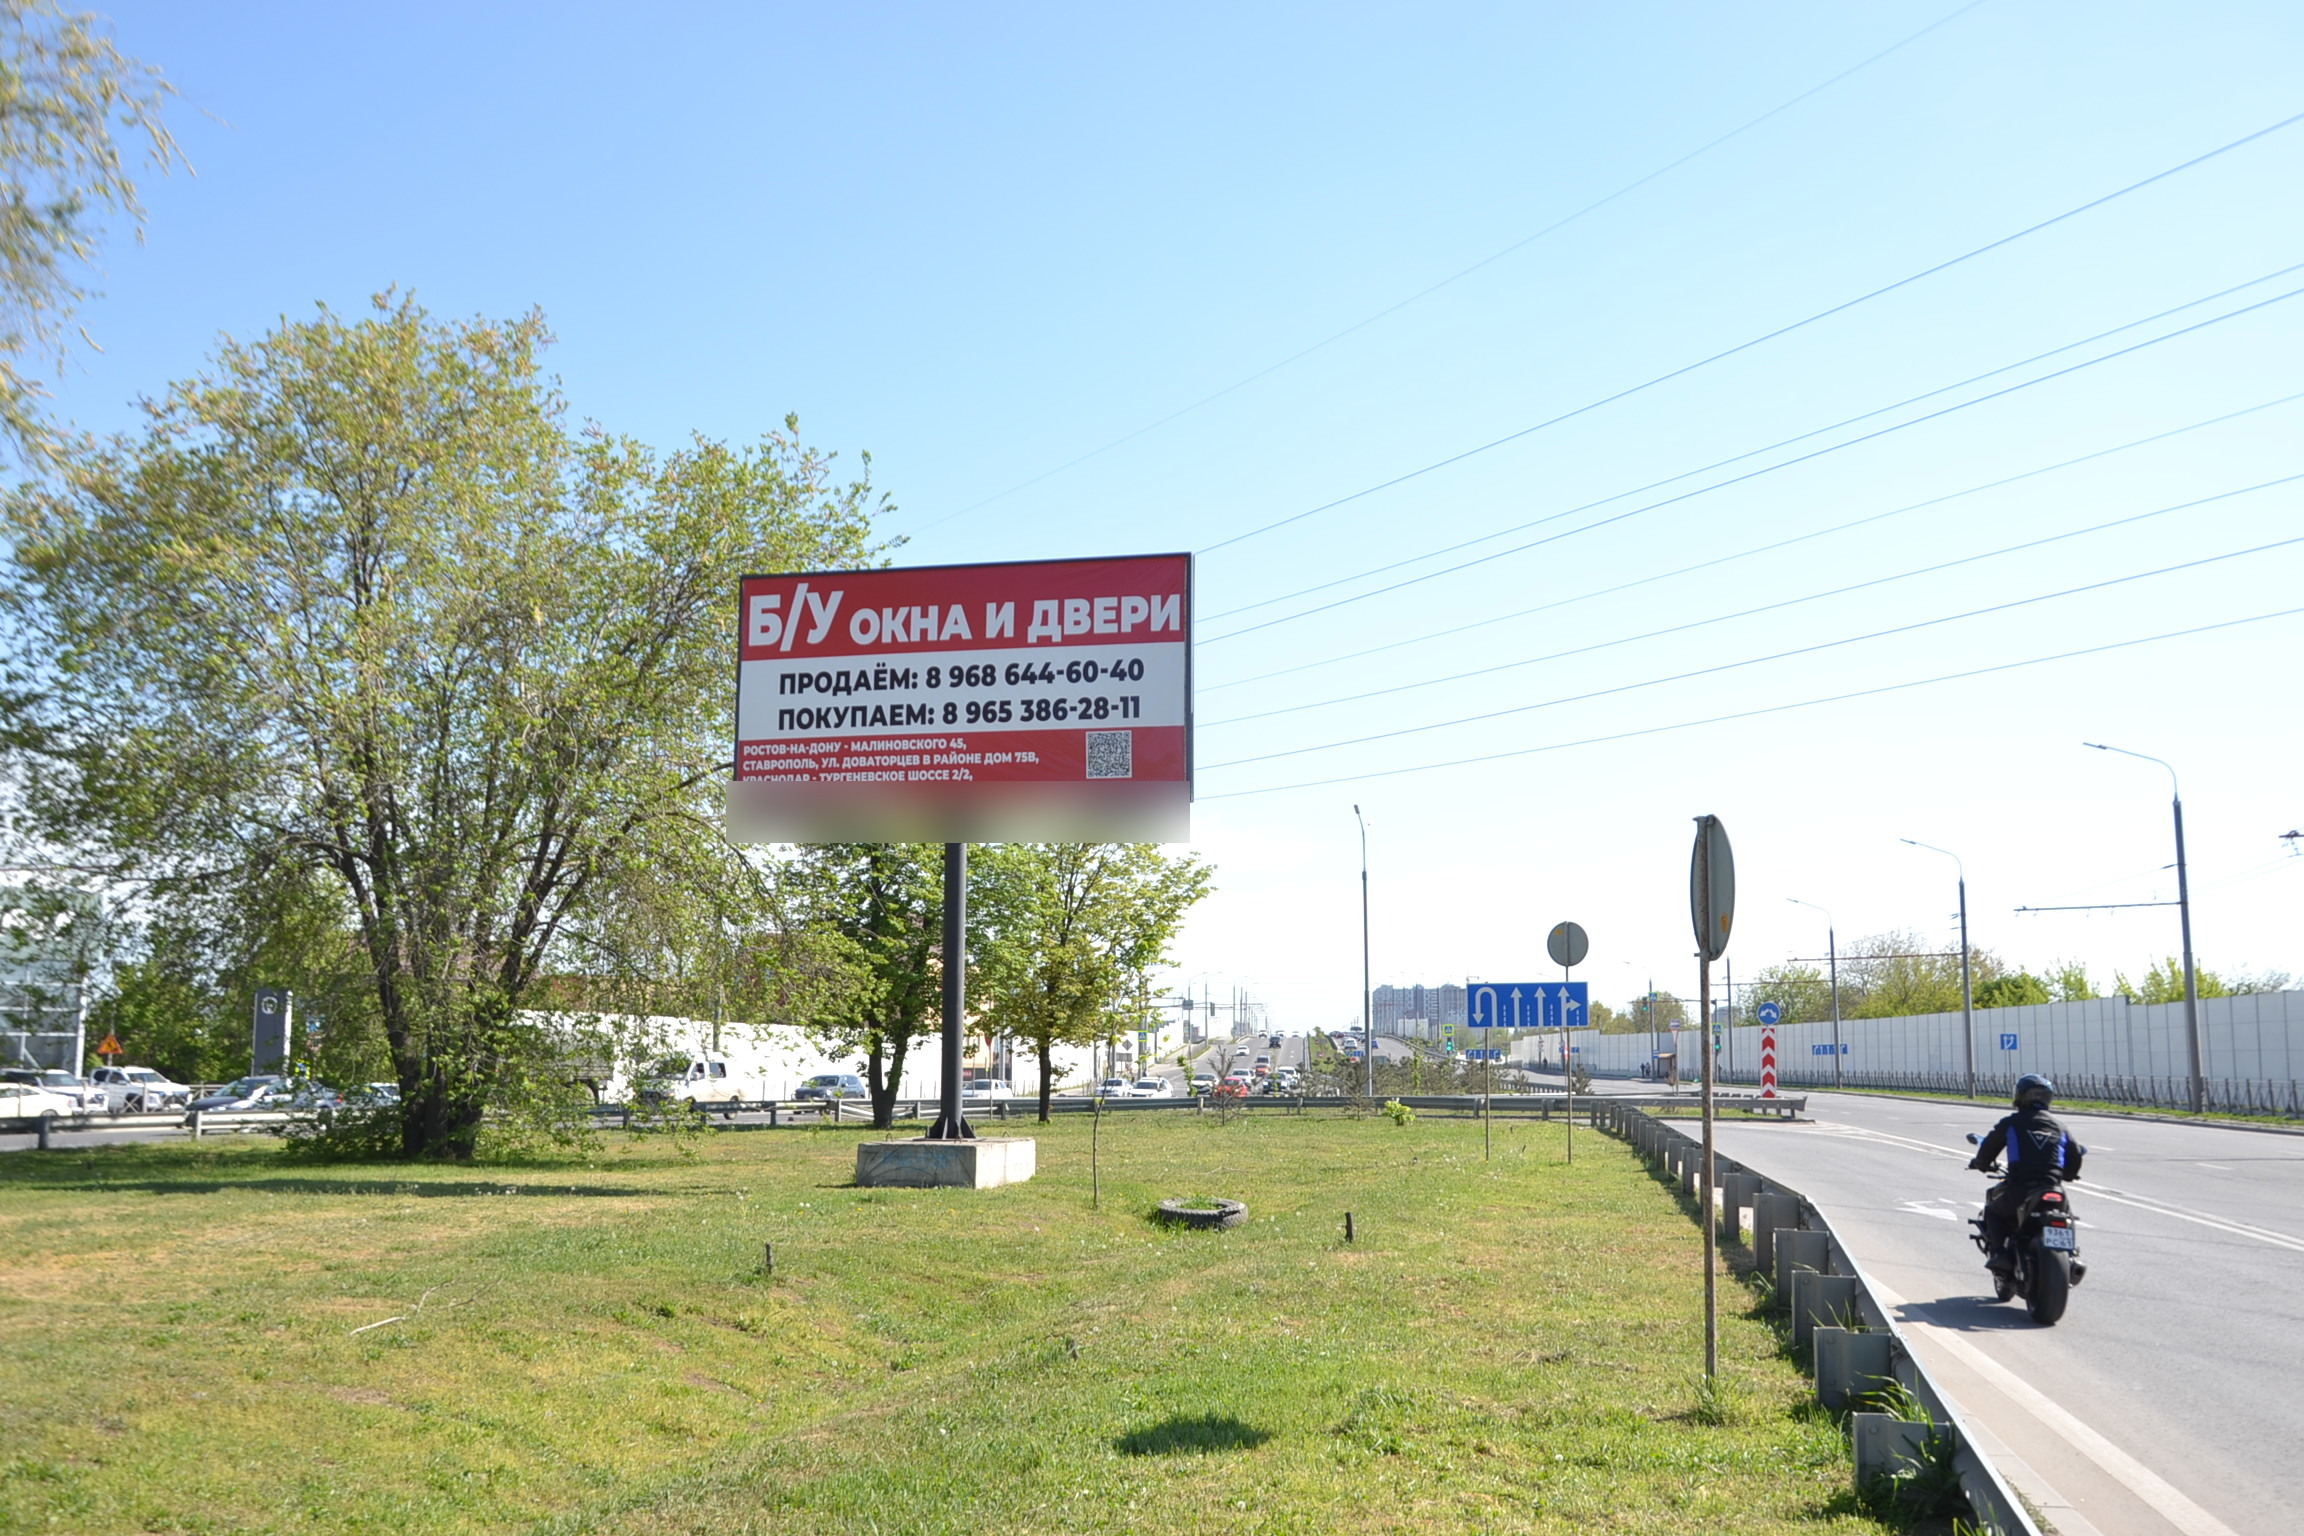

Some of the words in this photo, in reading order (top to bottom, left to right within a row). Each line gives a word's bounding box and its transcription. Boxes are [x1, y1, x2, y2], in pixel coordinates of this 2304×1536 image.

[749, 583, 844, 652] Б/У
[850, 604, 973, 645] ОКНА
[985, 601, 1015, 639] И
[1027, 594, 1181, 643] ДВЕРИ
[779, 662, 918, 696] ПРОДАЁМ:
[926, 666, 941, 689] 8
[949, 664, 996, 687] 968
[1004, 658, 1145, 686] 644-60-40
[778, 703, 935, 730] ПОКУПАЕМ:
[942, 702, 958, 725] 8
[965, 700, 1012, 724] 965
[1019, 695, 1140, 722] 386-28-11
[743, 742, 841, 756] РОСТОВ-НА-ДОНУ
[851, 738, 947, 752] МАЛИНОВСКОГО
[949, 737, 967, 751] 45,
[743, 758, 819, 771] СТАВРОПОЛЬ,
[821, 757, 840, 769] УЛ.
[842, 755, 920, 769] ДОВАТОРЦЕВ
[923, 754, 931, 765] В
[933, 751, 982, 765] РАЙОНЕ
[984, 752, 1012, 766] ДОМ
[1014, 751, 1039, 764] 75В,
[819, 770, 905, 782] ТУРГЕНЕВСКОЕ
[908, 769, 950, 781] ШОССЕ
[952, 767, 973, 781] 2/2,
